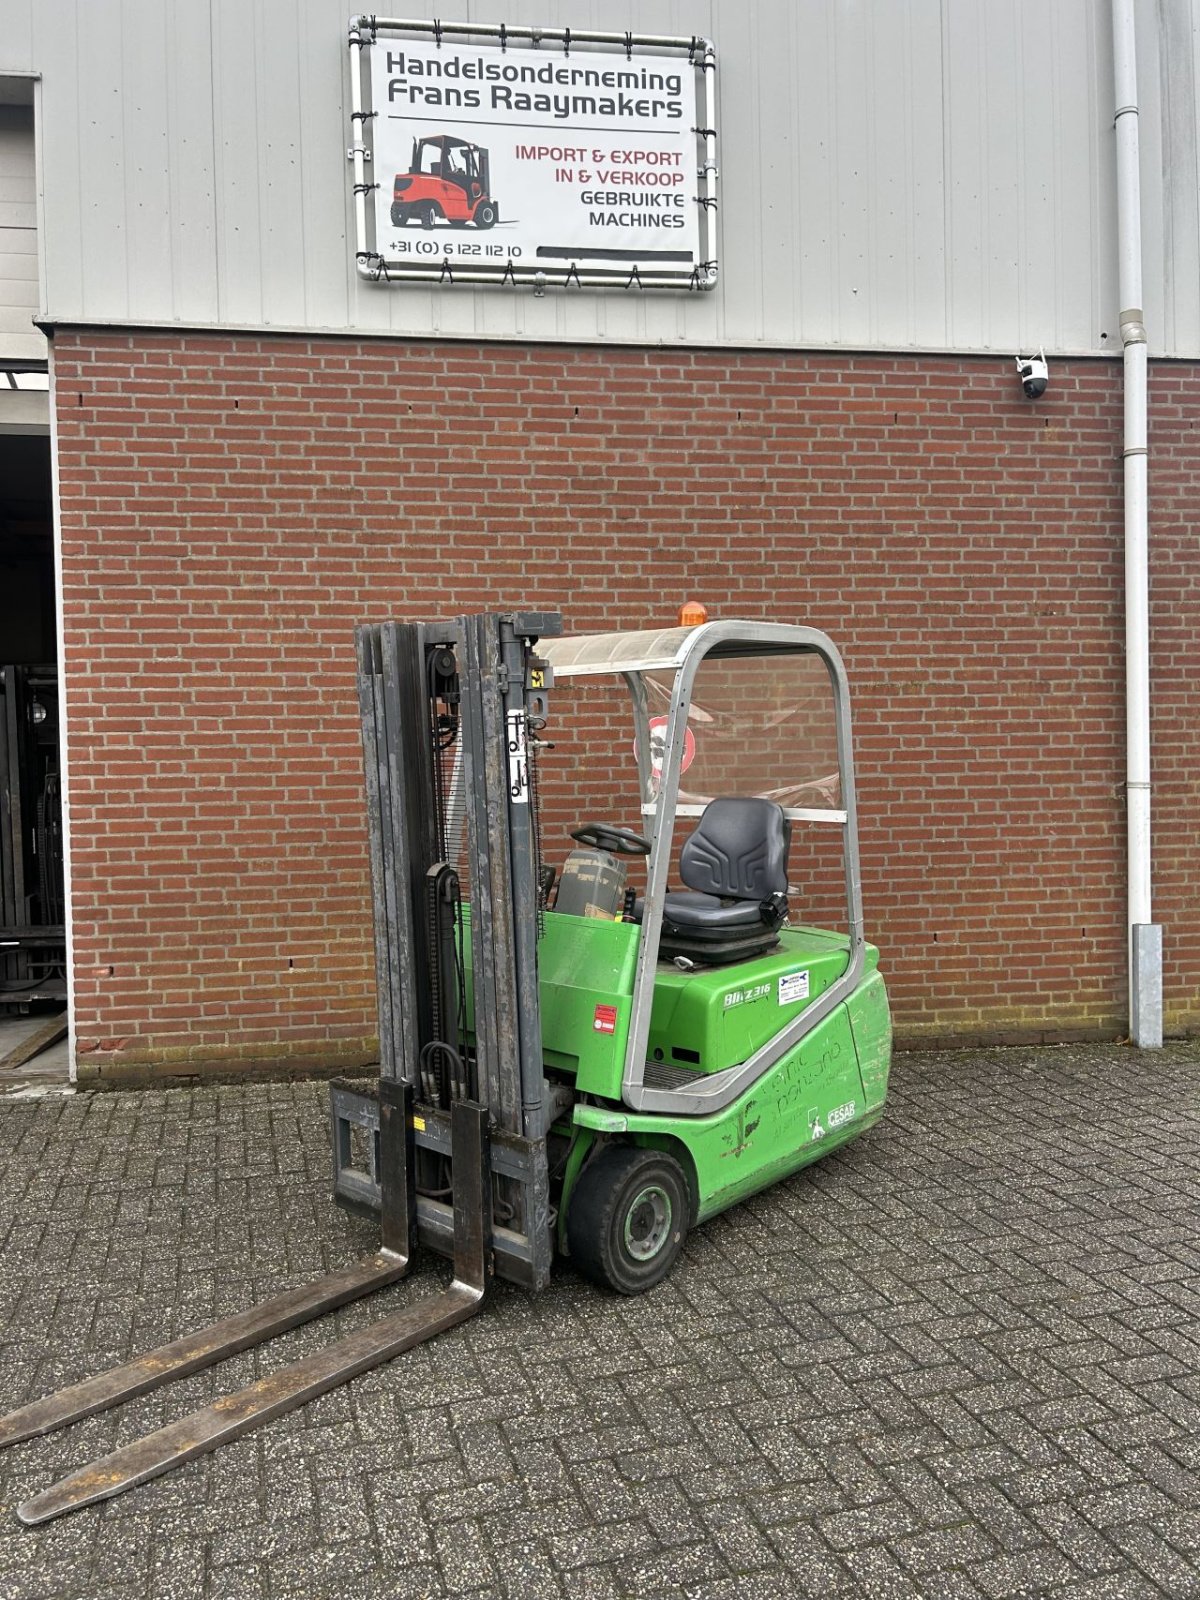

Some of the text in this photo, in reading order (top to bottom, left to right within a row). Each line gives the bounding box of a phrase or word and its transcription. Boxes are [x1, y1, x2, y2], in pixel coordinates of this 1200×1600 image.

[386, 51, 681, 96] Handelsonderneming
[388, 78, 683, 118] Frans Raaymakers
[515, 145, 683, 166] IMPORT & EXPORT
[555, 168, 684, 186] IN & VERKOOP
[580, 191, 685, 207] GEBRUIKTE
[589, 212, 685, 228] MACHINES
[389, 241, 522, 257] +31 (0) 6 122 112 10
[829, 1103, 855, 1126] CESAB
